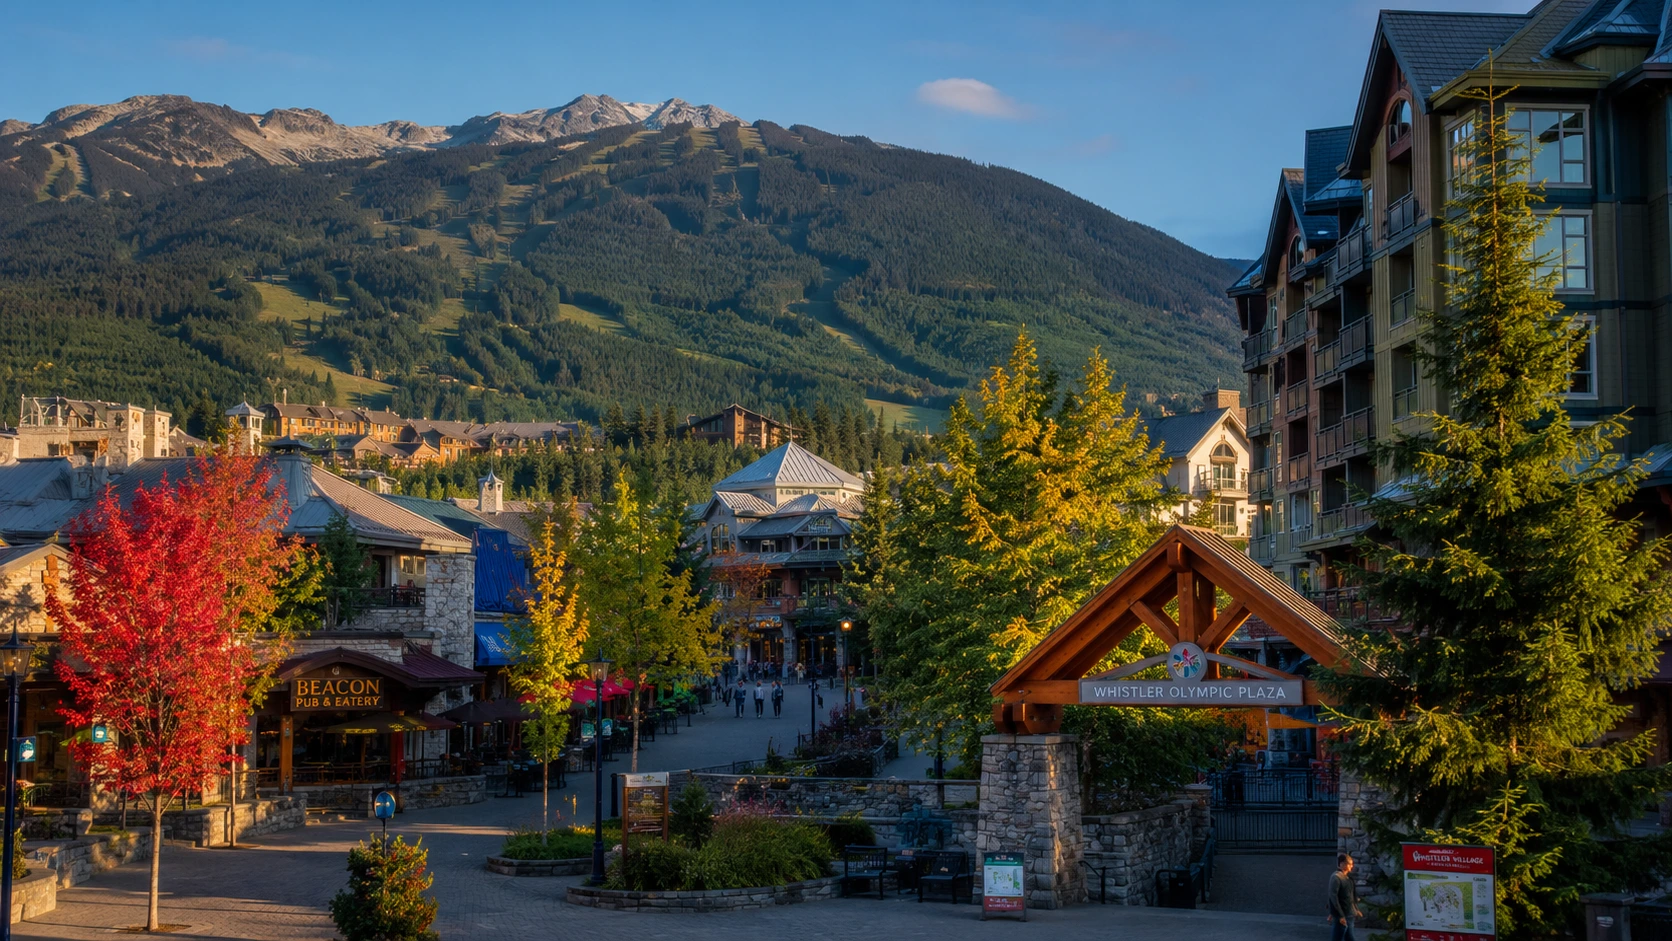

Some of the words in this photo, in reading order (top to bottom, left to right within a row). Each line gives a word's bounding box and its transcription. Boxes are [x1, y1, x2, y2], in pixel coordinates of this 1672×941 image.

[297, 679, 380, 696] BEACON
[1094, 686, 1163, 698] WHISTLER
[1169, 686, 1232, 698] OLYMPIC
[1238, 686, 1286, 699] PLAZA
[296, 697, 319, 708] PUB
[323, 697, 331, 707] &
[335, 696, 381, 707] EATERY
